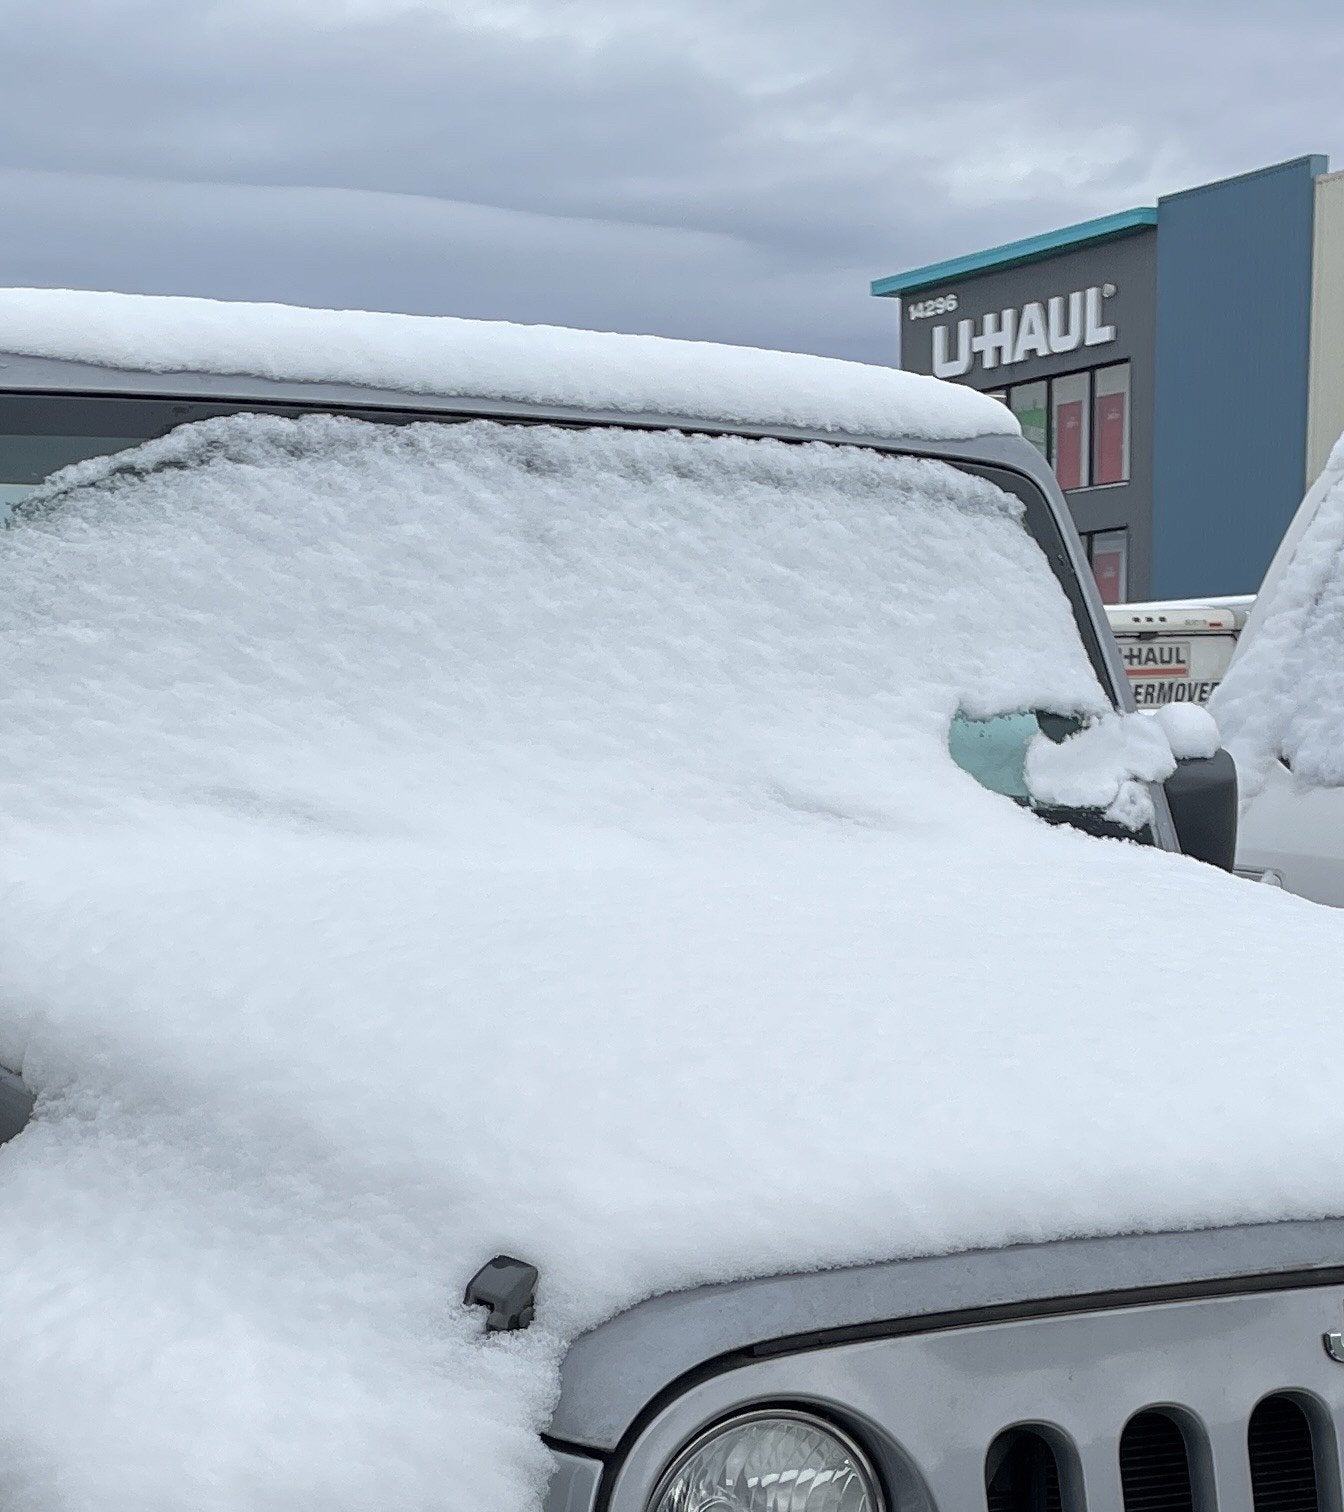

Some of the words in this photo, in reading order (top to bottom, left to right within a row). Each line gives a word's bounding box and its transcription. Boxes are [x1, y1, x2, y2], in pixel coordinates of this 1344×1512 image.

[908, 293, 958, 321] 14296
[931, 285, 1118, 379] U-HAUL
[1119, 646, 1188, 666] -HAUL
[1134, 681, 1221, 704] ERMOVE
